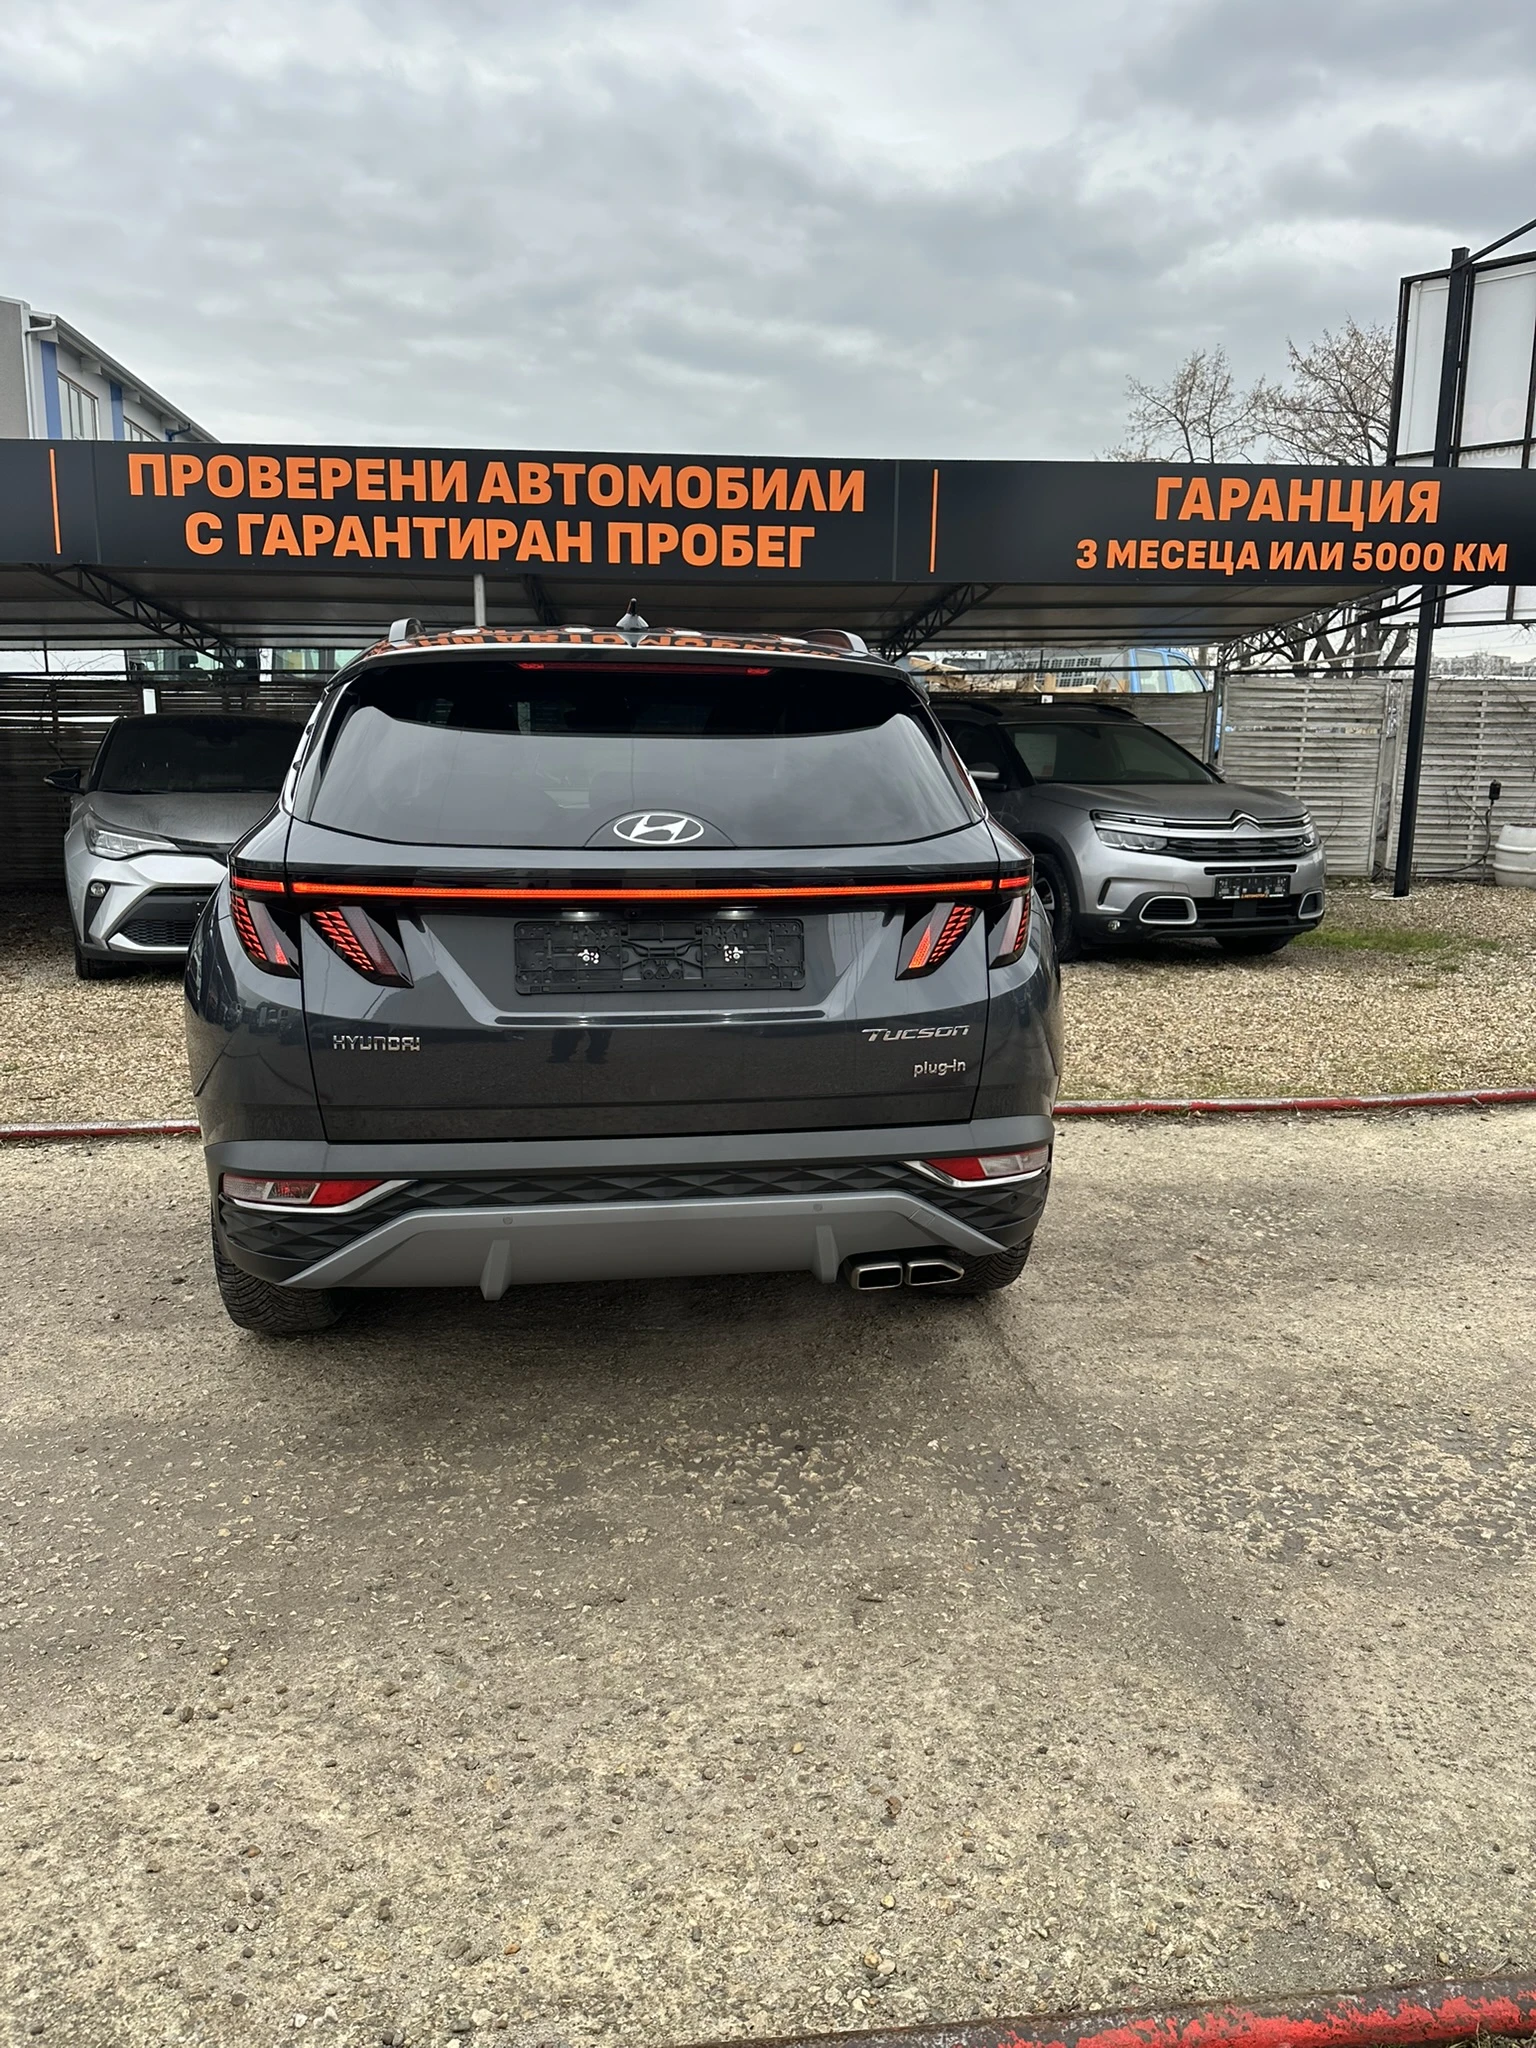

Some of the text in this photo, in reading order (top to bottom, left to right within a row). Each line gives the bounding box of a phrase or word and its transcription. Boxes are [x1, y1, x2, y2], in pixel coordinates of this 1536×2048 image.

[128, 453, 866, 512] ПРОВЕРЕНИ АВТОМОБИЛИ
[1154, 476, 1442, 532] ГАРАНЦИЯ
[184, 511, 816, 569] С ГАРАНТИРАН ПРОБЕГ
[1075, 538, 1508, 576] 3 МЕСЕЦА ИЛИ 5000 КМ
[332, 1034, 421, 1052] HYUNDAI
[913, 1058, 967, 1077] plug-in
